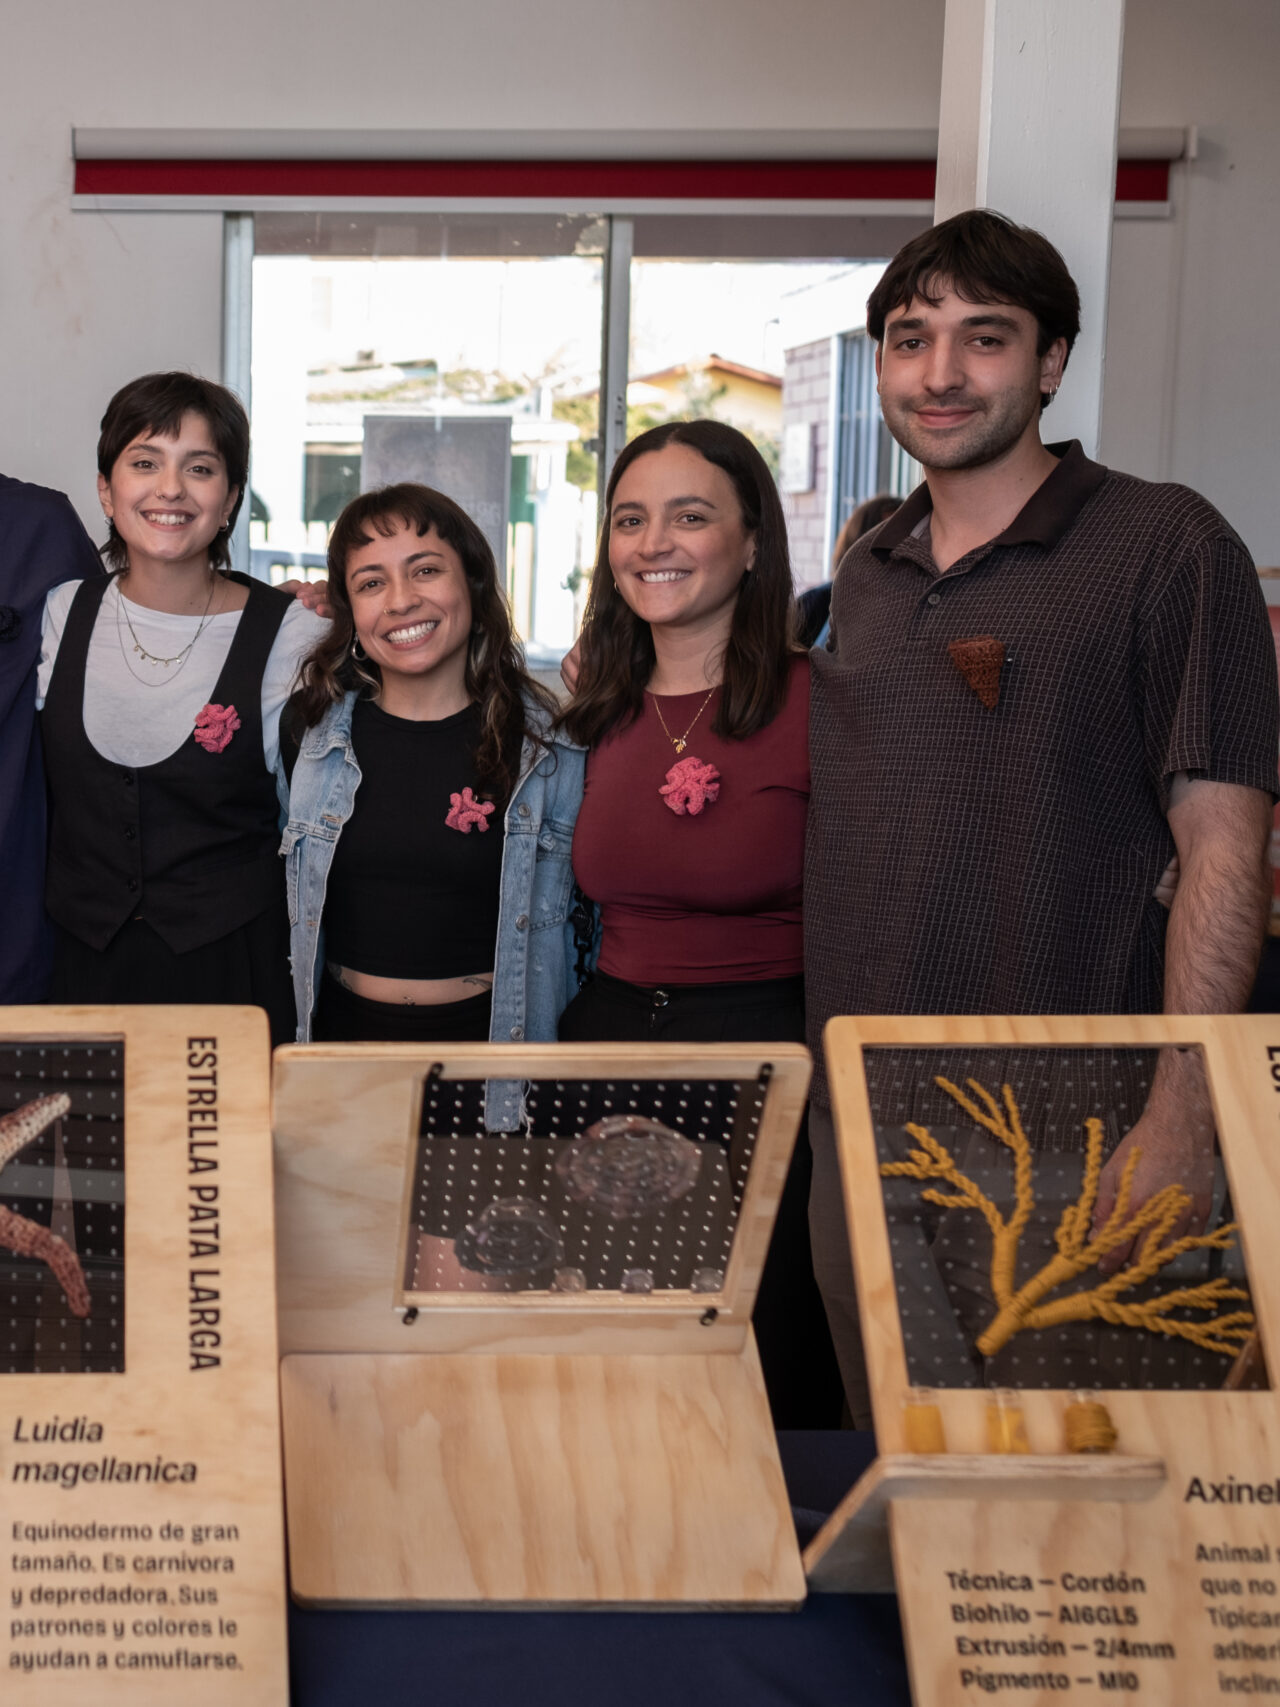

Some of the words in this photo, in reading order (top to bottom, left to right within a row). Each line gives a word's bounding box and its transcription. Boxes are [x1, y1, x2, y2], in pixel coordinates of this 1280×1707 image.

[186, 1036, 219, 1175] ESTRELLA
[188, 1184, 220, 1259] PATA
[188, 1269, 222, 1372] LARGA
[13, 1416, 104, 1443] Luidia
[12, 1455, 198, 1490] magellanica
[11, 1521, 153, 1544] Equinodermo
[159, 1521, 185, 1542] de
[191, 1525, 240, 1546] gran
[102, 1553, 126, 1572] Es
[1194, 1543, 1271, 1564] Animal
[945, 1569, 1034, 1592] Técnica
[1060, 1570, 1147, 1595] Cordón
[1200, 1578, 1243, 1597] que
[1247, 1578, 1277, 1596] no
[11, 1589, 23, 1608] y
[178, 1585, 219, 1605] Sus
[950, 1602, 1031, 1624] Biohilo
[10, 1618, 107, 1640] patrones
[112, 1621, 125, 1639] y
[131, 1617, 213, 1637] colores
[218, 1617, 238, 1638] le
[955, 1634, 1067, 1658] Extrusión
[1094, 1637, 1177, 1660] 2/4mm
[8, 1648, 91, 1674] ayudan
[96, 1653, 108, 1669] a
[959, 1666, 1071, 1694] Pigmento
